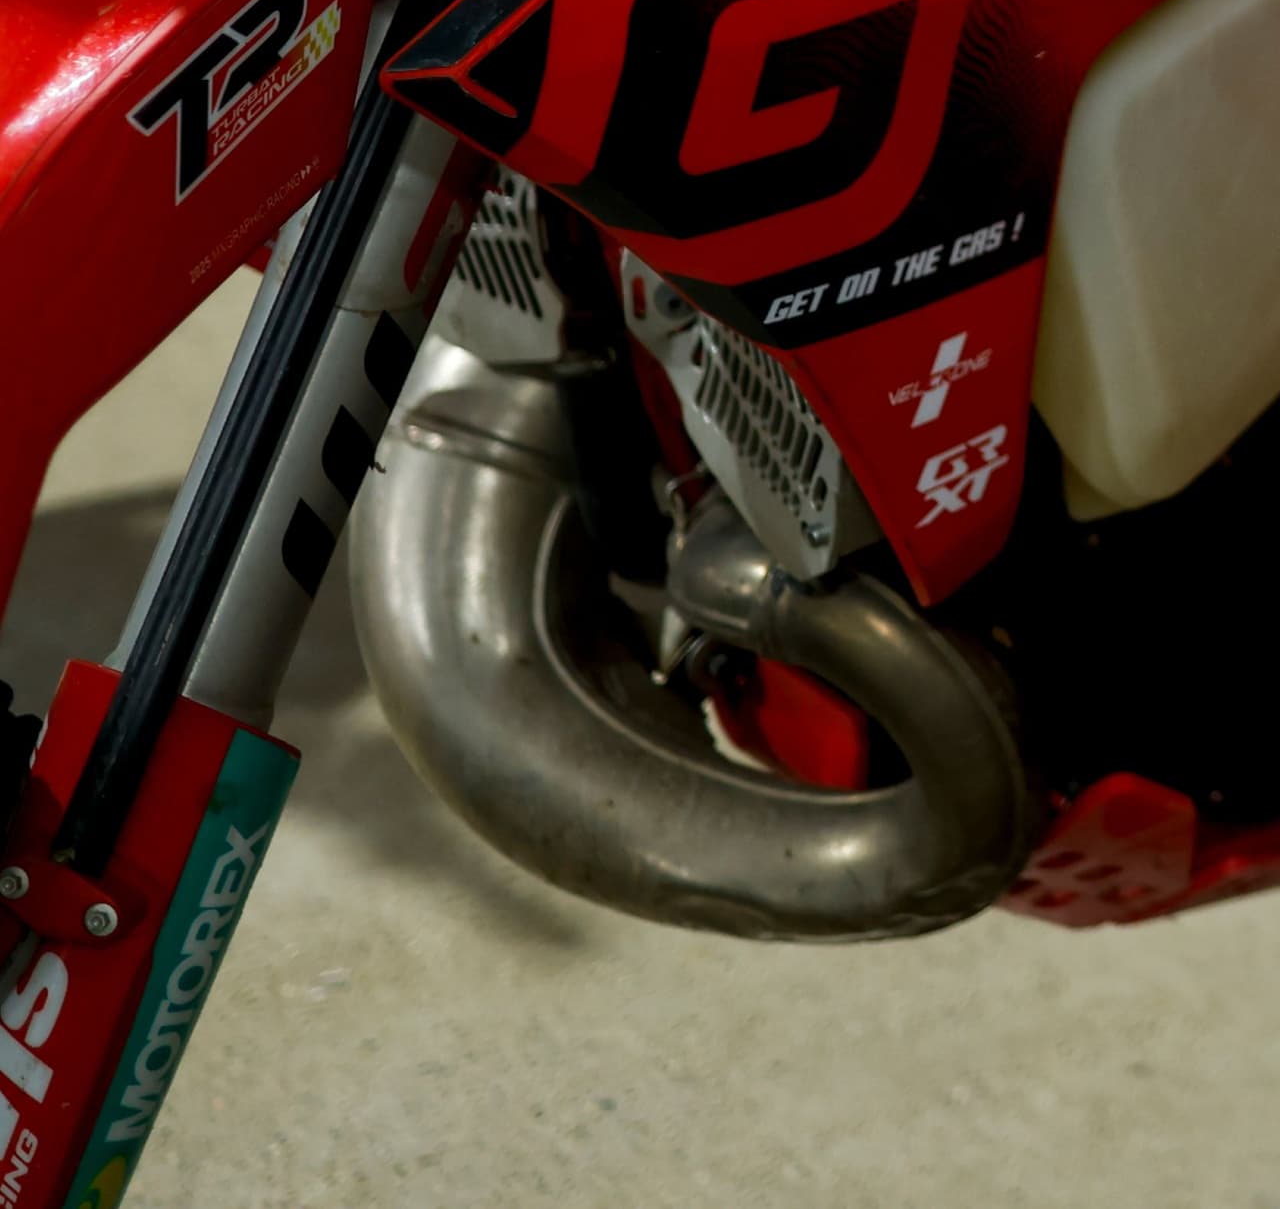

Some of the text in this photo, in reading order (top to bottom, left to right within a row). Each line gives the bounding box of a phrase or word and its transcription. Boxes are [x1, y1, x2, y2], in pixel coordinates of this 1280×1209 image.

[211, 66, 281, 139] TURBAT
[213, 57, 311, 158] RACING
[763, 284, 830, 325] GET
[836, 267, 881, 304] ON
[891, 244, 944, 287] THE
[949, 220, 1006, 267] GAS
[106, 820, 270, 1143] MOTOREX
